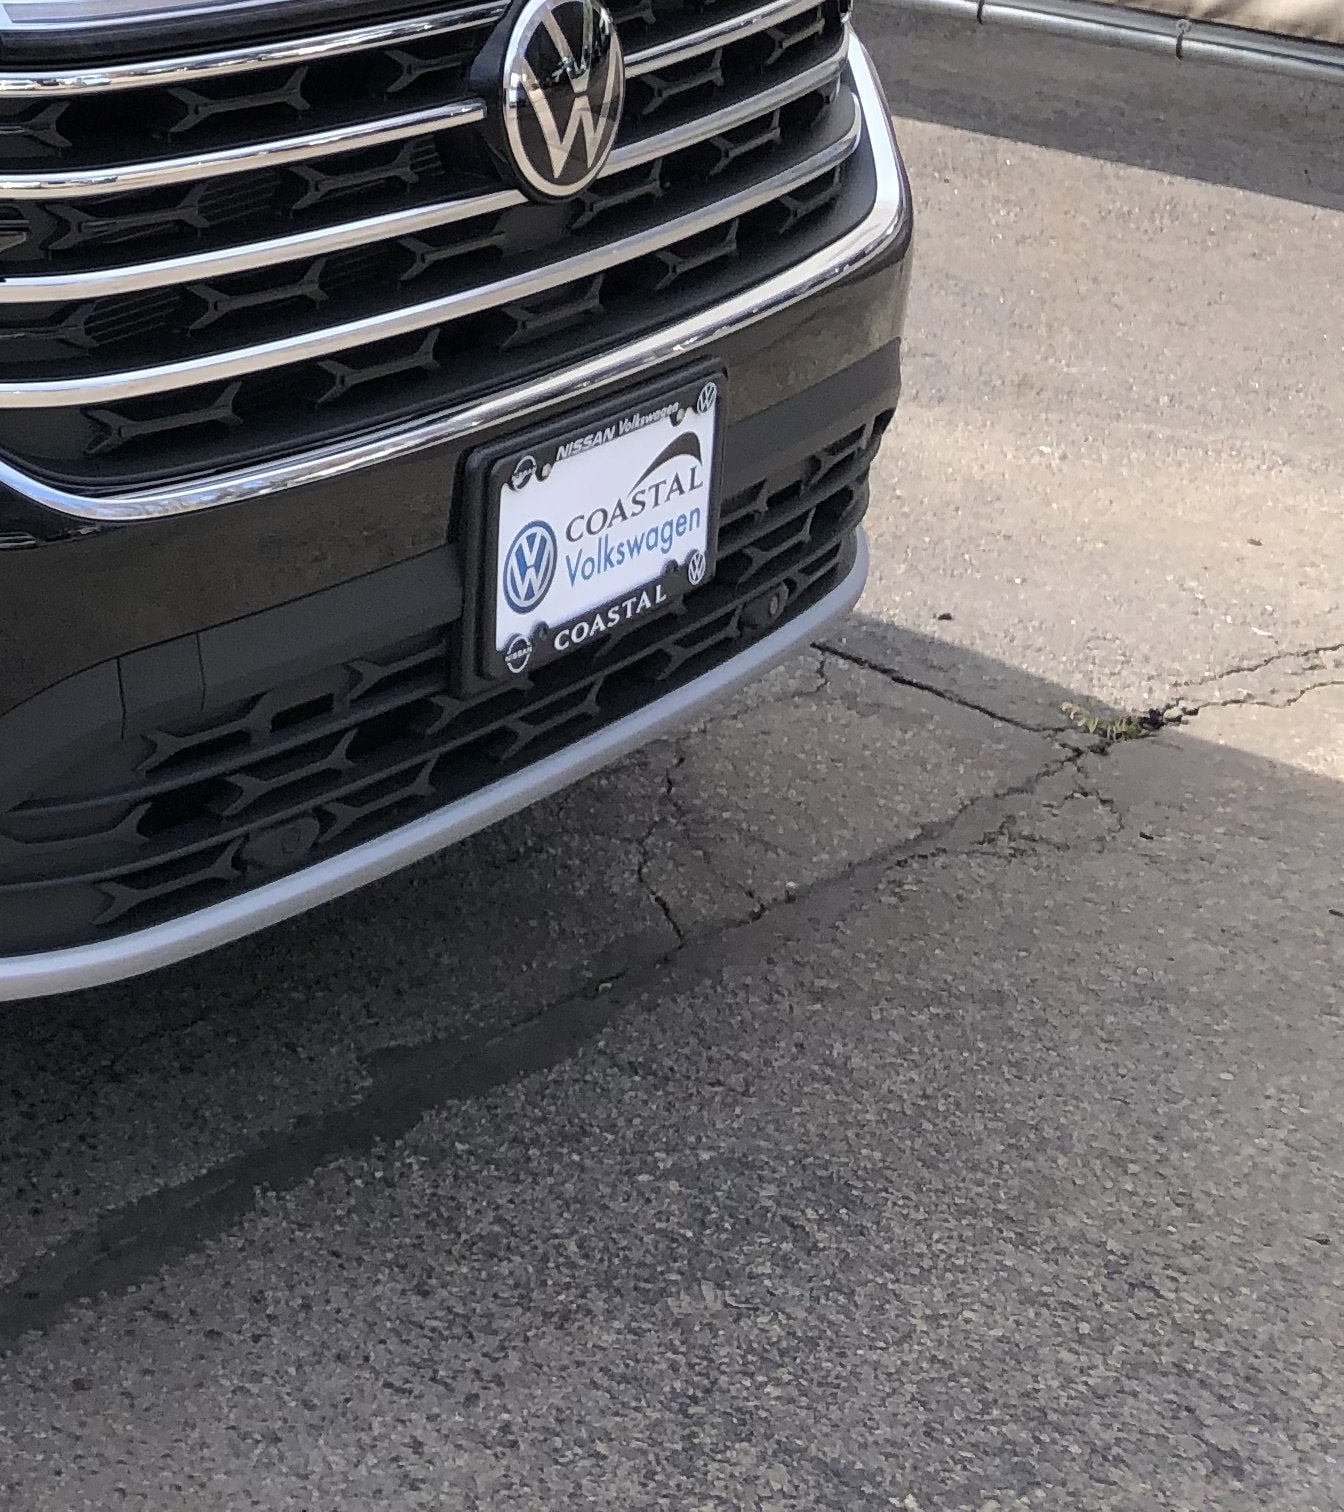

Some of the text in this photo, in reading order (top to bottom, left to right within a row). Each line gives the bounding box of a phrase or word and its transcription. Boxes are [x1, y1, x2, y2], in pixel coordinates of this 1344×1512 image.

[555, 401, 680, 461] NISSAN Volkswagen
[565, 465, 704, 543] COASTAL
[565, 506, 701, 588] Volkswagen
[553, 584, 667, 651] COASTAL
